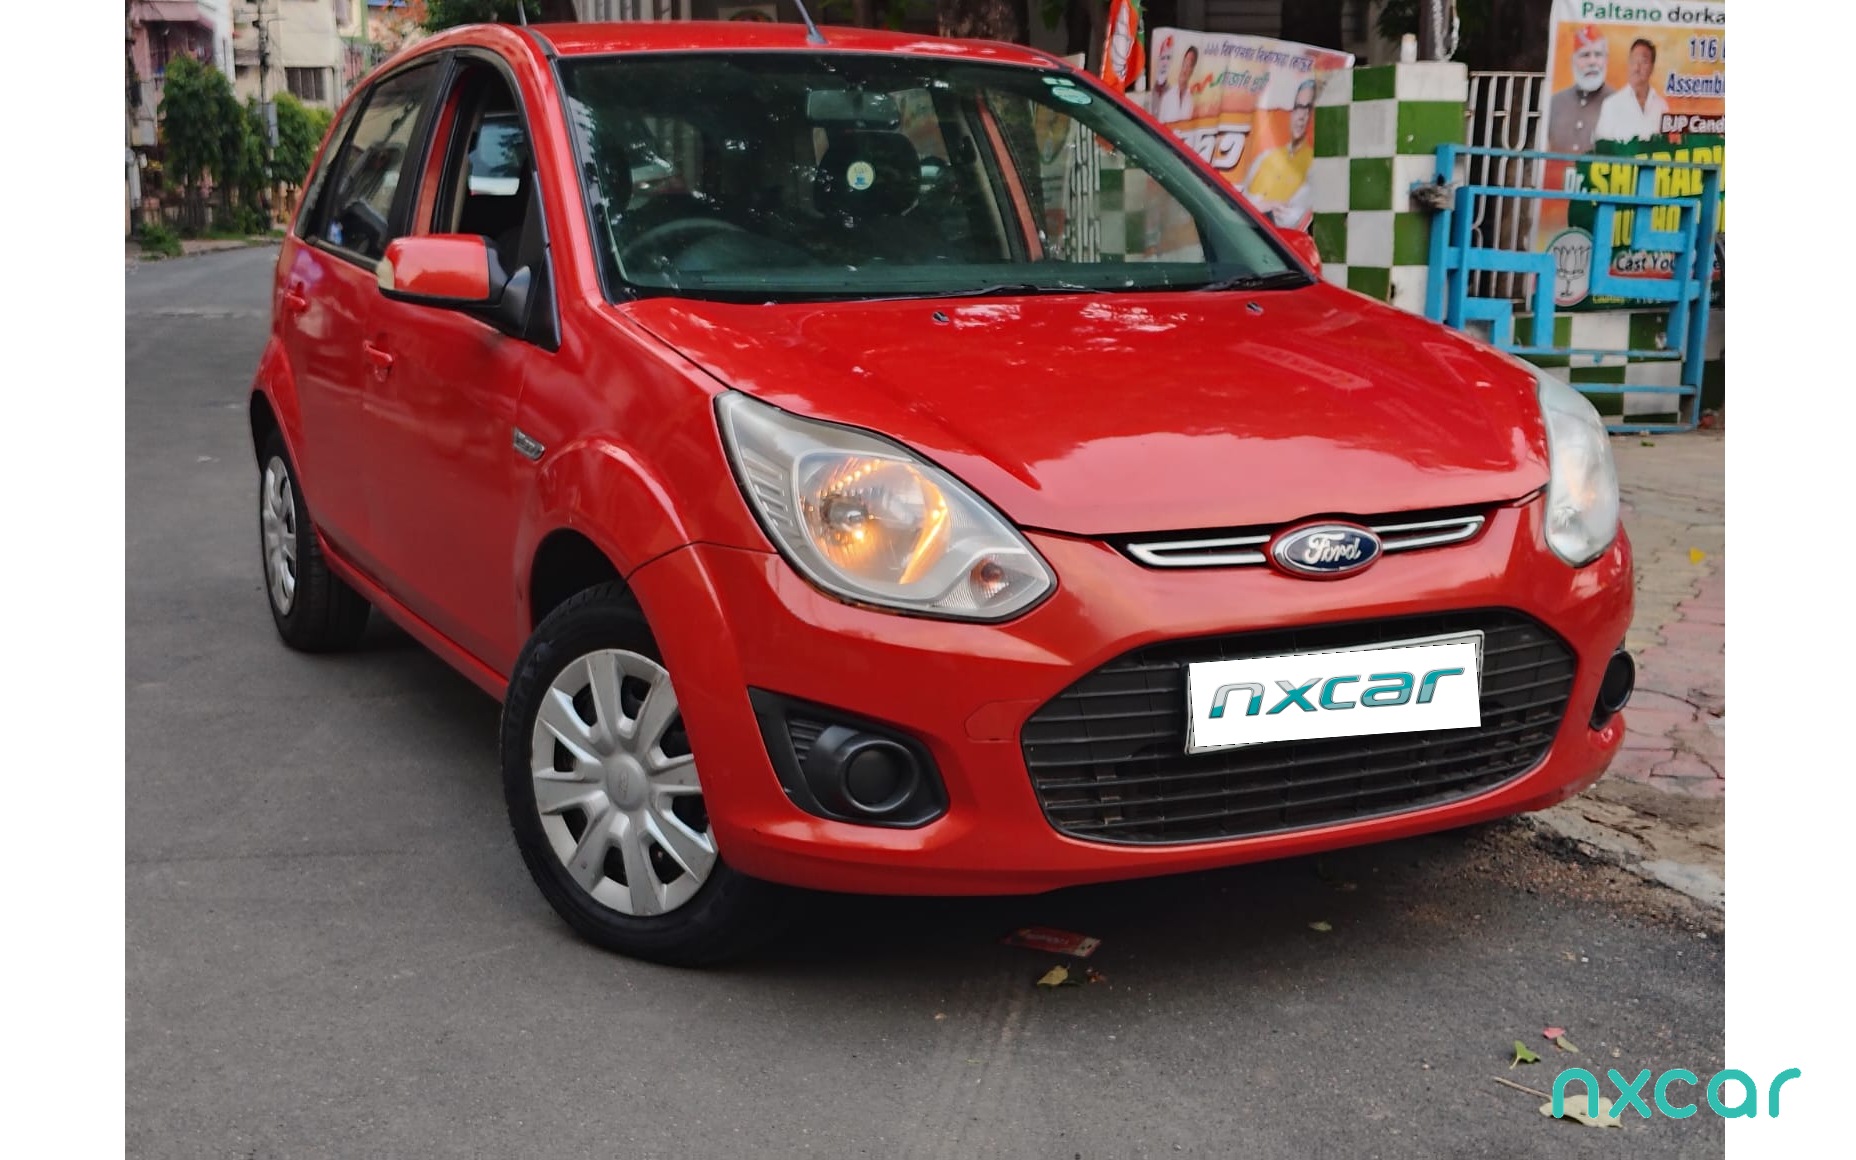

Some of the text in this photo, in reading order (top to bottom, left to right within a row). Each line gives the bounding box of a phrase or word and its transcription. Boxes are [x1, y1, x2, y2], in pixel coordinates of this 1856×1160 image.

[1581, 1, 1662, 22] Paltano
[1689, 38, 1718, 59] 116
[1662, 115, 1687, 133] BJP
[1616, 254, 1646, 272] Cast
[1302, 532, 1362, 565] Ford
